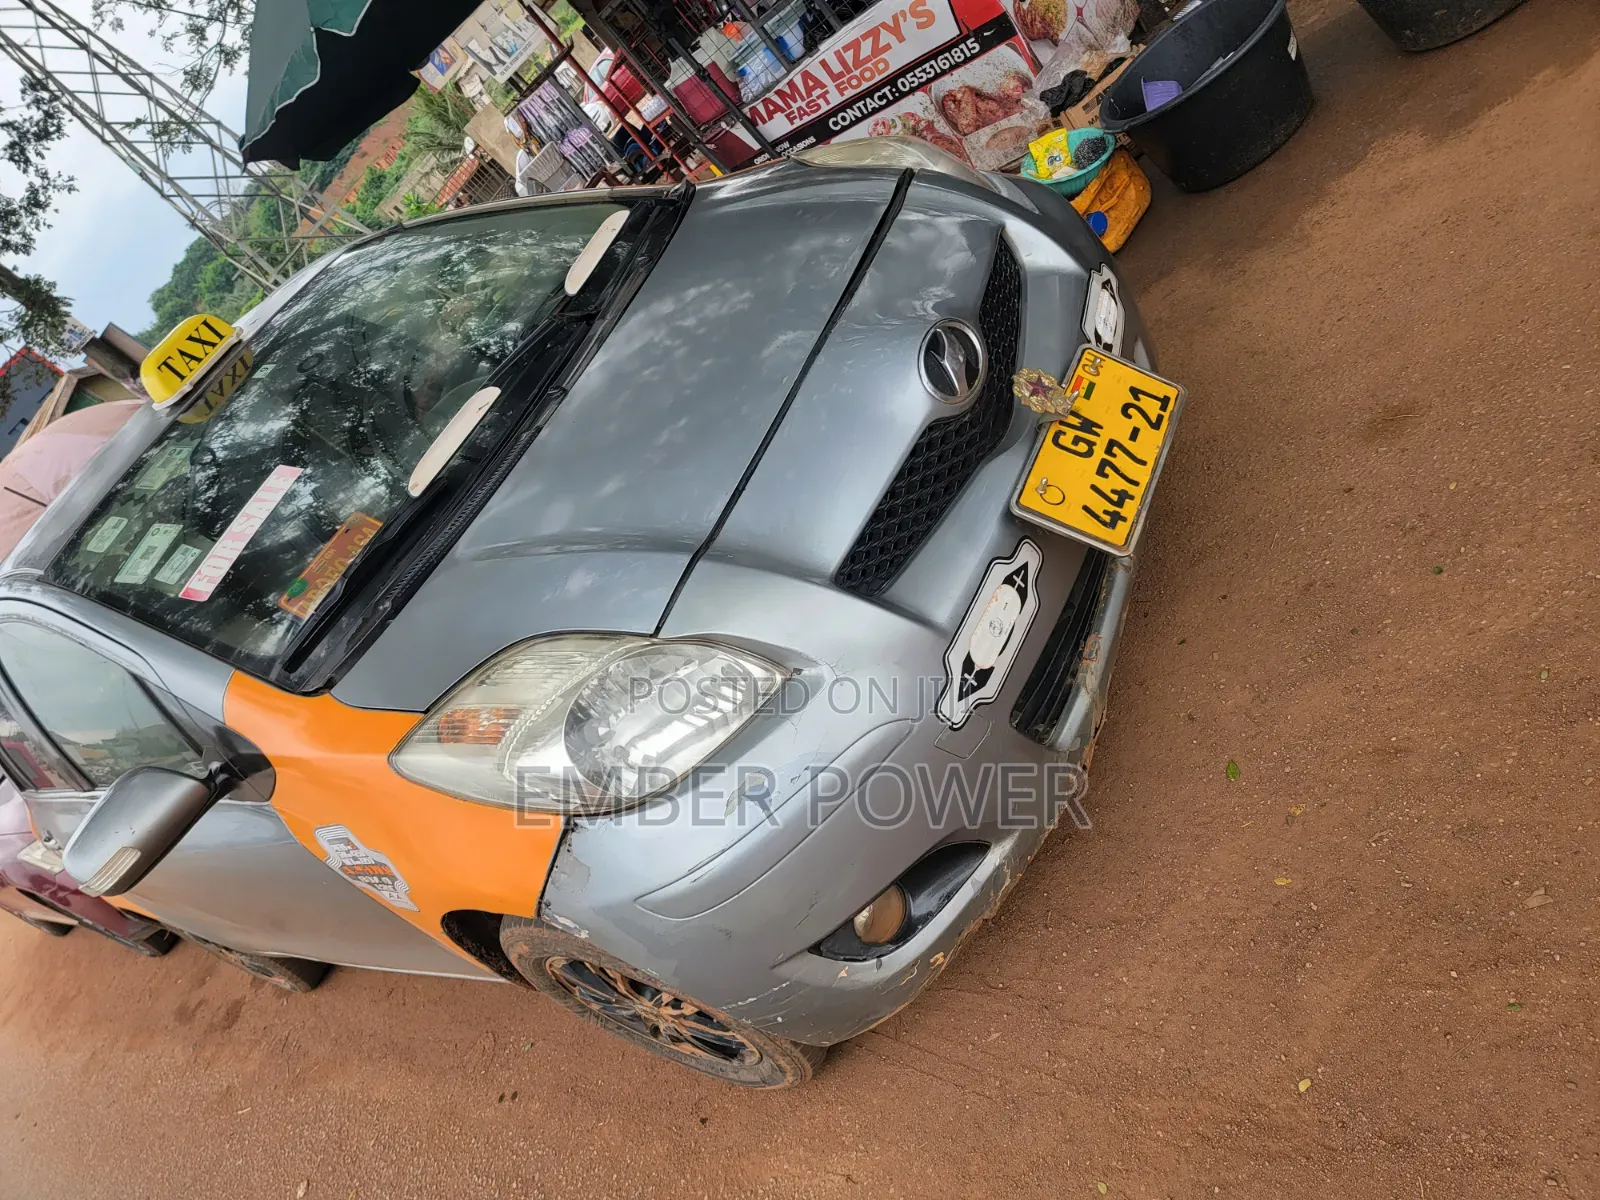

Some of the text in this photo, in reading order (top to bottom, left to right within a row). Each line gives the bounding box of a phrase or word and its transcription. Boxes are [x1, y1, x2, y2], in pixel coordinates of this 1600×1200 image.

[819, 0, 935, 83] LIZZY'S
[784, 57, 890, 126] FAST FOOD
[828, 37, 981, 131] CONTACT: 0553161815
[157, 318, 227, 383] TAXI
[1051, 409, 1104, 459] GW
[1081, 385, 1171, 531] 4477-21
[188, 475, 298, 592] FOR SALE
